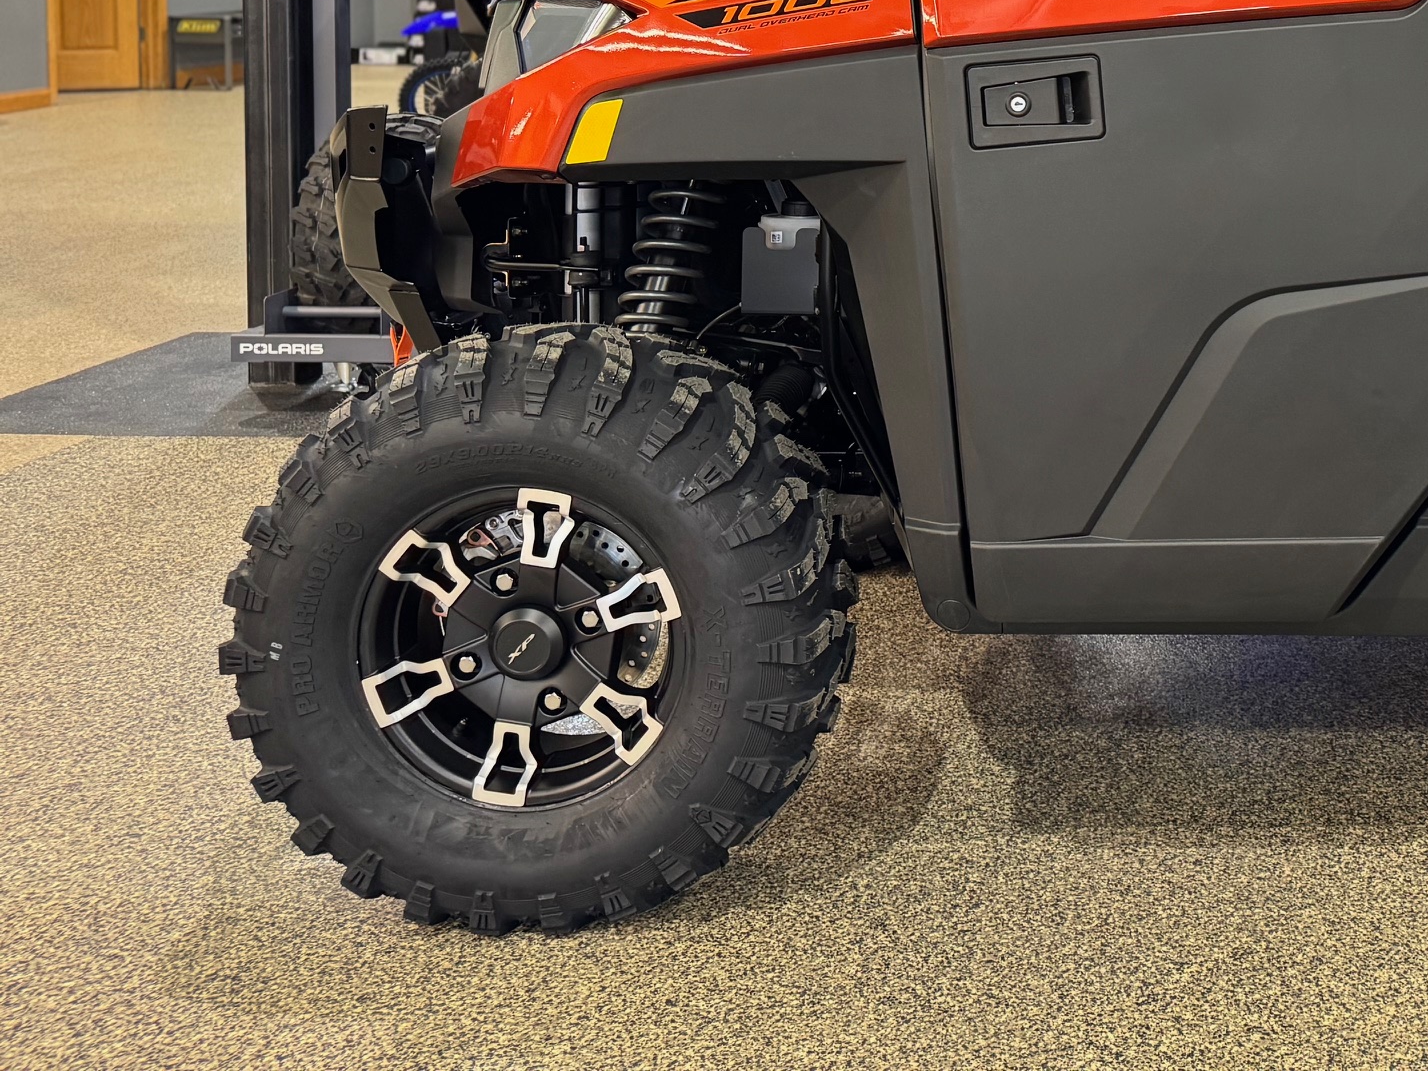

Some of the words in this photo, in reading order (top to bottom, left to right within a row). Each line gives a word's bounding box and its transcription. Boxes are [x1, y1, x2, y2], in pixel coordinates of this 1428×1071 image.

[717, 23, 756, 35] DUAL
[759, 9, 836, 28] OVERHEAD
[838, 3, 870, 15] CAM
[239, 342, 324, 356] POLARIS
[507, 633, 536, 665] XP
[664, 605, 732, 800] X-TERRAIN
